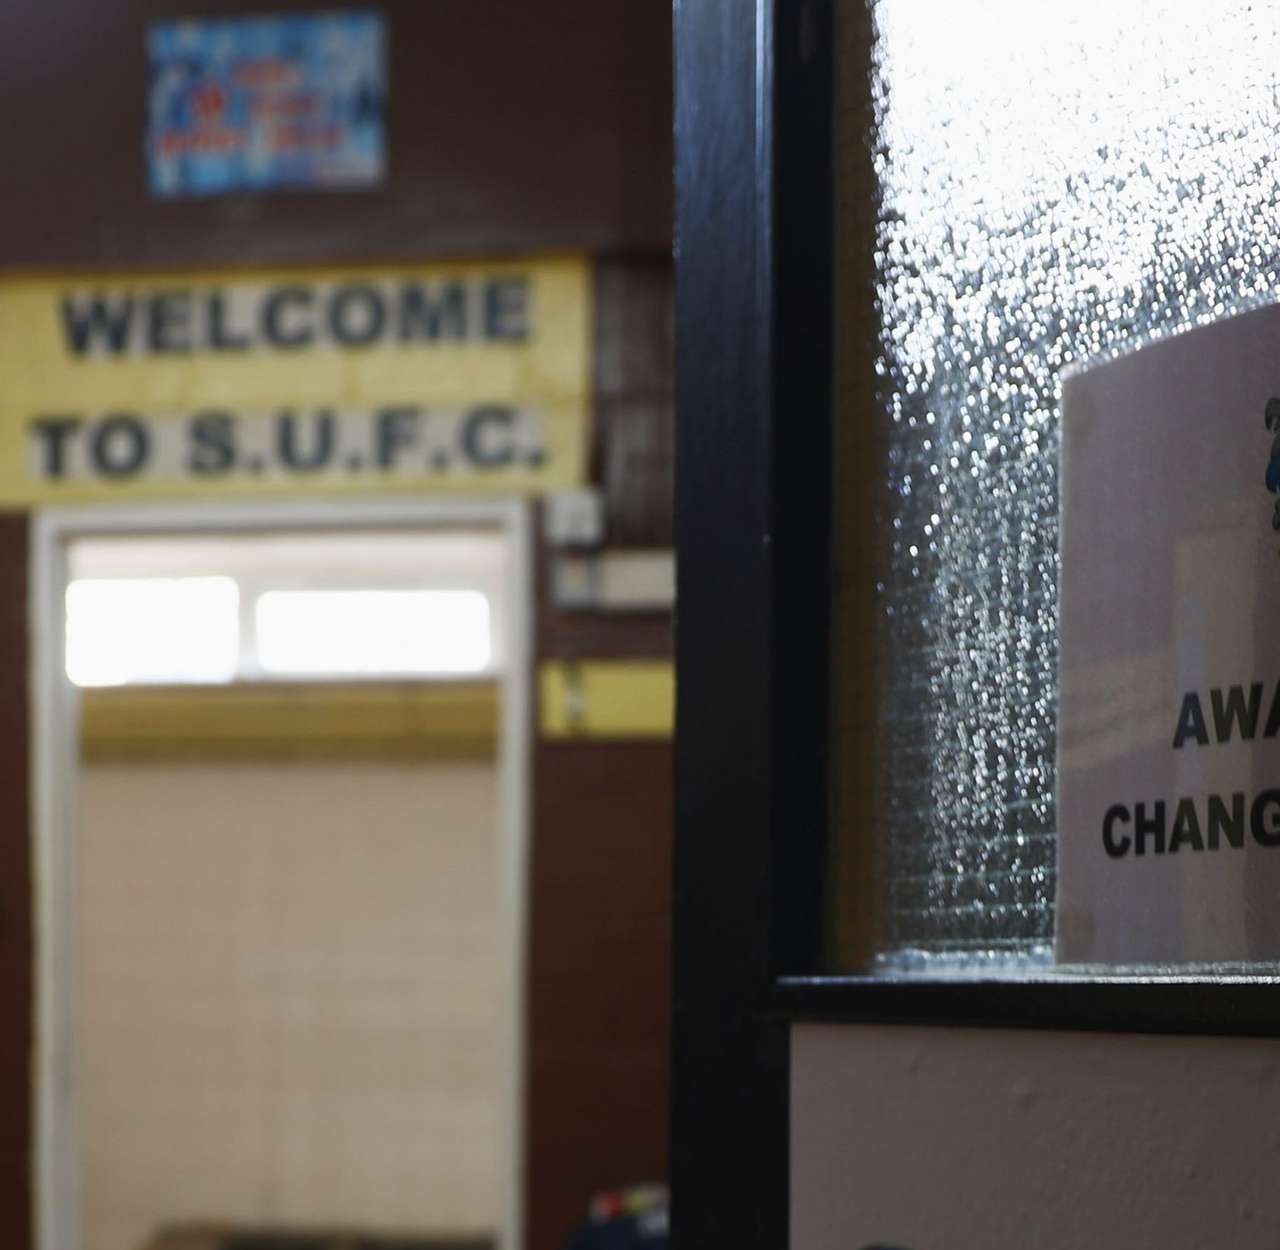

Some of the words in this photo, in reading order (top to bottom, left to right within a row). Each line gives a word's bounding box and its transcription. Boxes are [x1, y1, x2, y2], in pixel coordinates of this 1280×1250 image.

[60, 275, 532, 356] WELCOME
[28, 417, 150, 480] TO
[184, 407, 548, 475] S.U.F.C.
